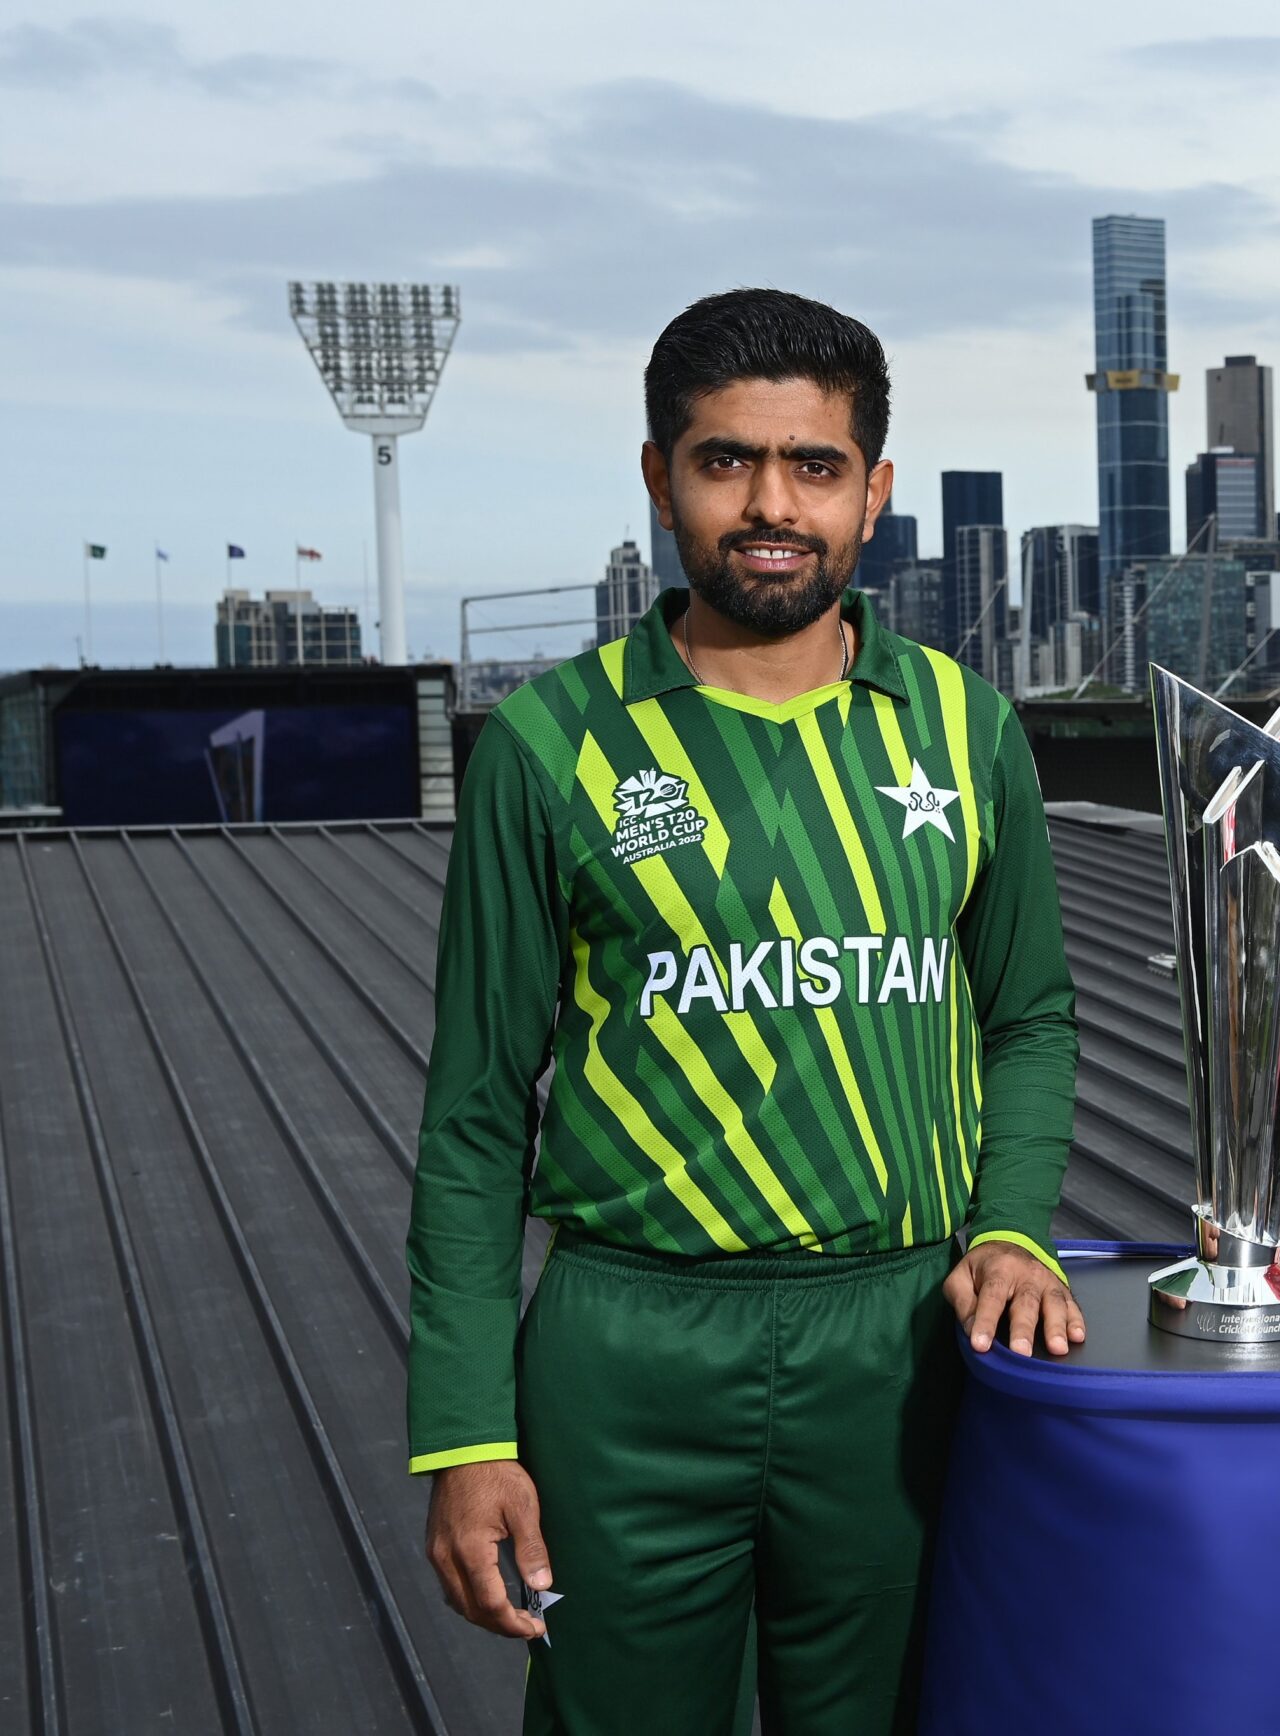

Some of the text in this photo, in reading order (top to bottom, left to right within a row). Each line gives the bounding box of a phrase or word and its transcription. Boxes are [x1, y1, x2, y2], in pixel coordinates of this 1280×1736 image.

[378, 446, 392, 465] 5
[616, 809, 695, 842] MEN'S T20
[620, 816, 637, 828] ICC
[611, 820, 705, 857] WORLD CUP
[623, 834, 702, 864] AUSTRALIA 2022
[639, 936, 948, 1016] PAKISTAN
